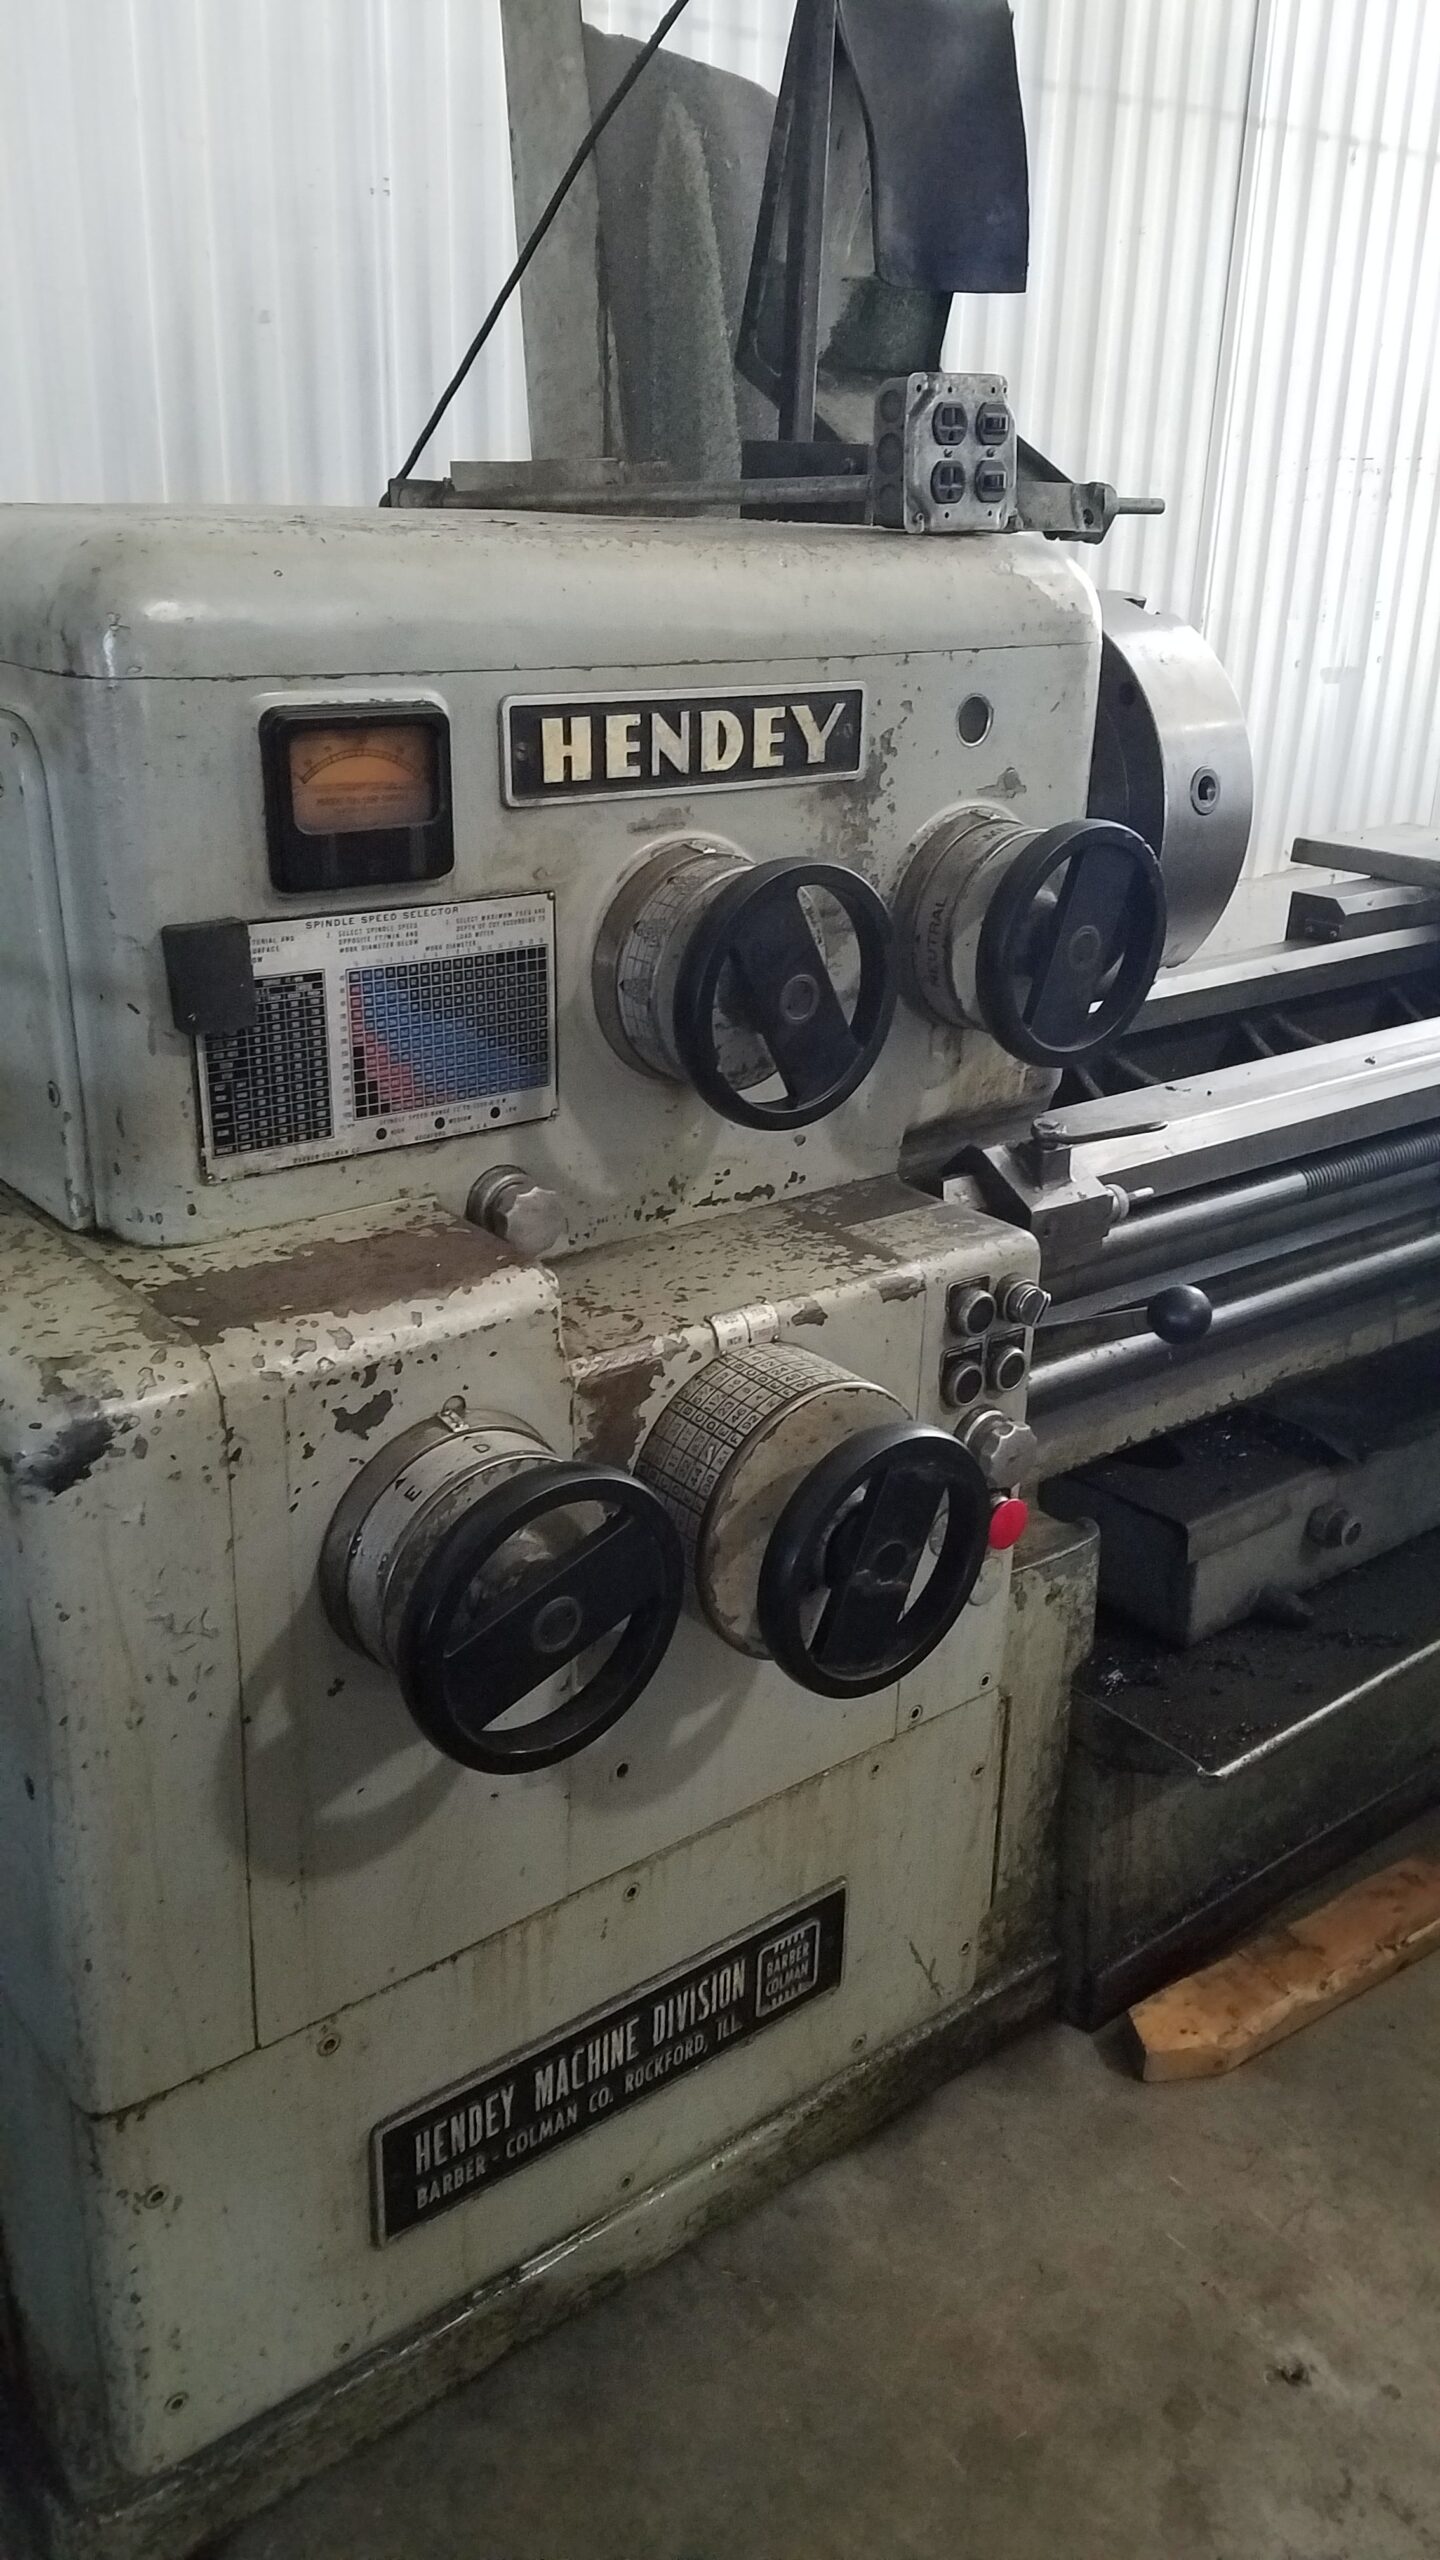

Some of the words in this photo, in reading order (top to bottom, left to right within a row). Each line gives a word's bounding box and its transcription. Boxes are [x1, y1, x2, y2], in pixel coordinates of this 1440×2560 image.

[541, 702, 846, 785] HENDEY
[306, 918, 355, 930] SPINDLE
[361, 913, 397, 924] SPEED
[402, 906, 459, 919] SELECTOR
[928, 896, 948, 987] NEUTRAL
[682, 1406, 694, 1416] B
[734, 1363, 745, 1371] B
[695, 1413, 705, 1423] C
[745, 1368, 757, 1377] C
[706, 1420, 717, 1431] D
[718, 1401, 735, 1417] 23
[758, 1376, 768, 1384] D
[770, 1366, 789, 1376] 24
[718, 1427, 730, 1438] E
[731, 1407, 748, 1423] 46
[769, 1382, 781, 1391] E
[785, 1373, 802, 1382] 48
[729, 1434, 741, 1445] F
[741, 1414, 759, 1431] 92
[781, 1388, 793, 1397] F
[472, 1443, 491, 1454] D
[403, 1485, 423, 1502] E
[765, 1959, 809, 1997] COLMAN
[766, 1941, 810, 1978] BARBER
[415, 2084, 515, 2175] HENDEY
[535, 2017, 640, 2112] MACHINE
[652, 1958, 745, 2047] DIVISION
[416, 2154, 487, 2210] BARBER
[506, 2103, 578, 2159] COLMAN
